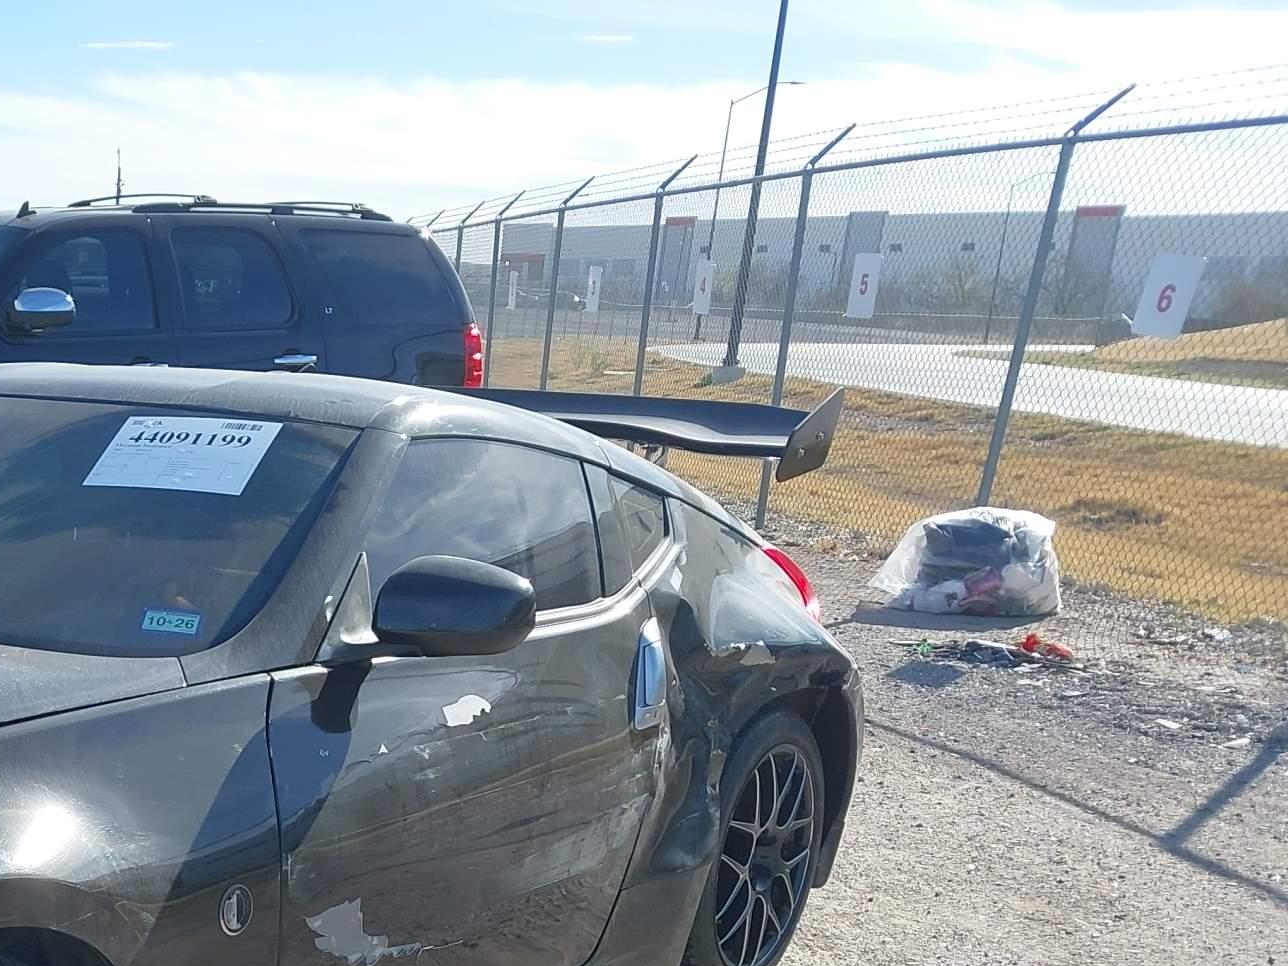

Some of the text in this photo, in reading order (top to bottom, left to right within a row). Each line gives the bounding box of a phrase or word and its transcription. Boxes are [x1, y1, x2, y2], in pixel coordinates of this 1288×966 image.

[699, 276, 708, 296] 4
[858, 272, 870, 296] 5
[1156, 283, 1177, 313] 6
[128, 429, 253, 449] 44091199
